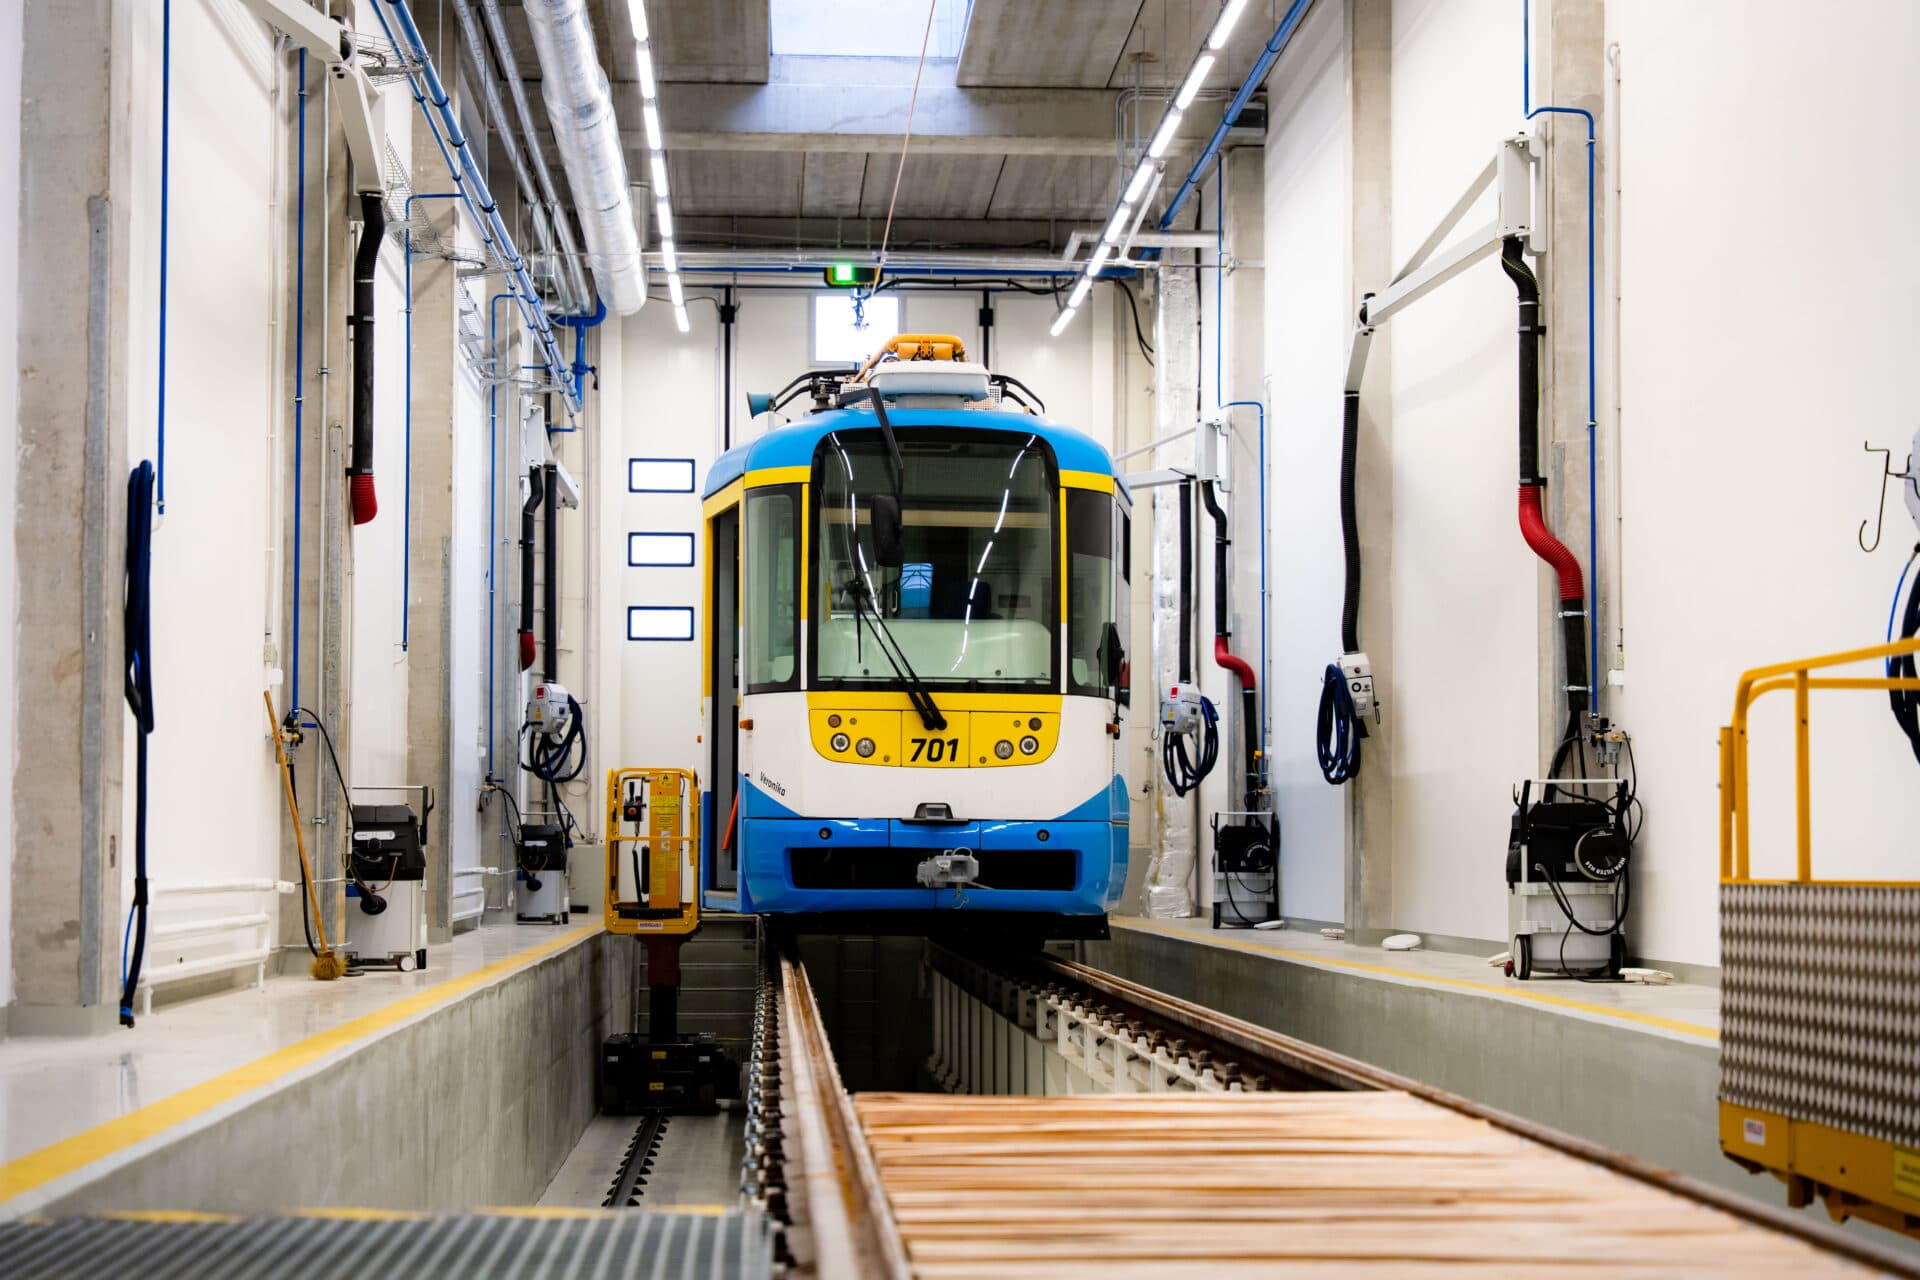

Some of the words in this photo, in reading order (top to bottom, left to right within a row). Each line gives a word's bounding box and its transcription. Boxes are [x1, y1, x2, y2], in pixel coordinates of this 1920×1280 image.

[910, 738, 959, 762] 701
[760, 771, 786, 796] Veronika
[1595, 868, 1615, 876] FILTER
